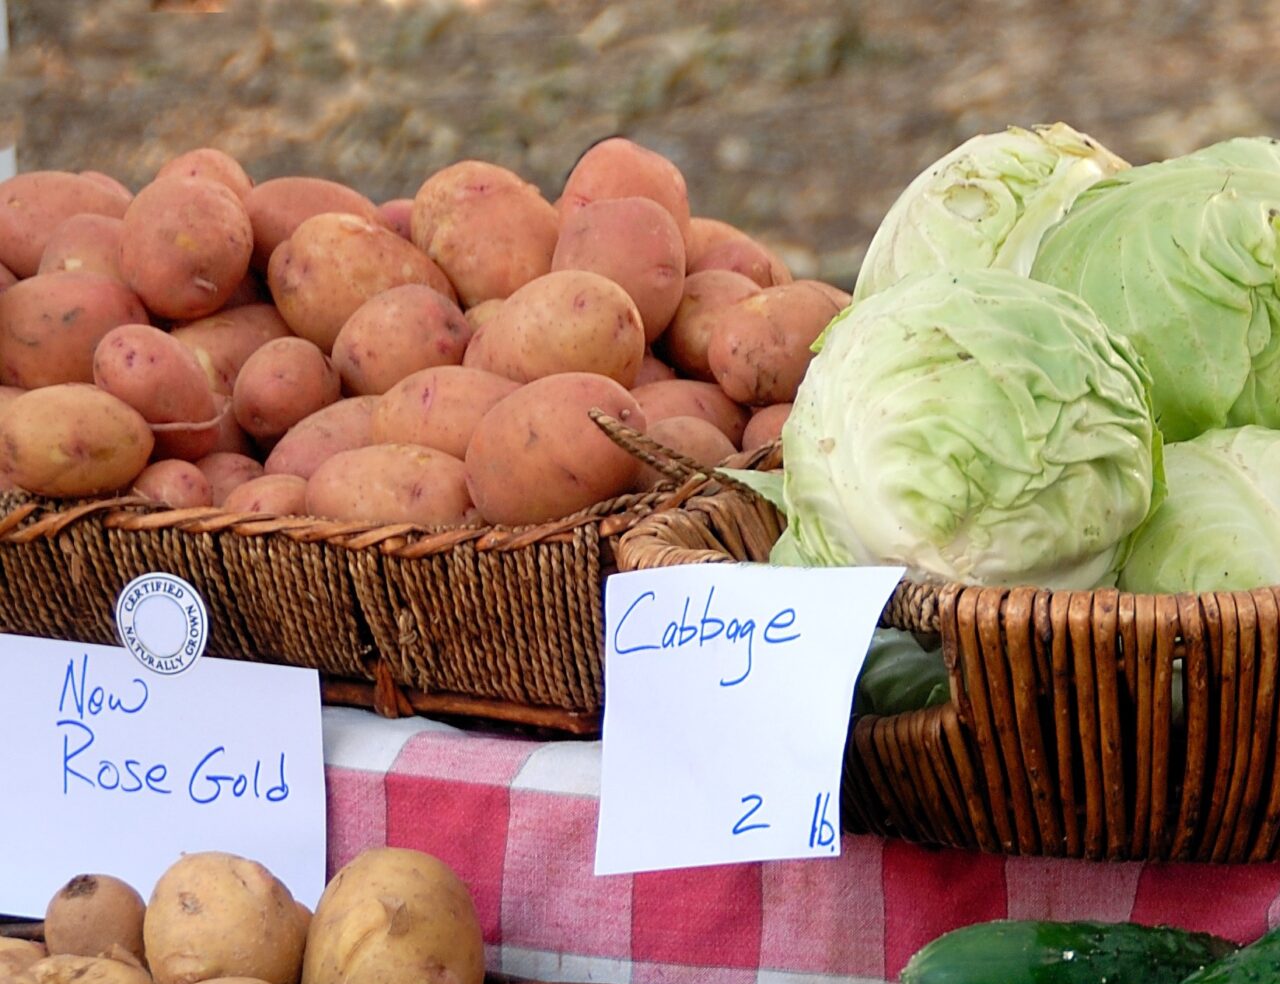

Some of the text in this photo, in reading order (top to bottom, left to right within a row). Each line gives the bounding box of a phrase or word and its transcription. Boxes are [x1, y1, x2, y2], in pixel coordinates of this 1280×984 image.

[124, 580, 184, 612] CERTIFIED
[124, 603, 200, 671] NATURALLY GROWN
[614, 585, 801, 687] Cabbage
[58, 653, 149, 720] New
[56, 719, 290, 804] Rose Gold
[731, 793, 771, 836] 2
